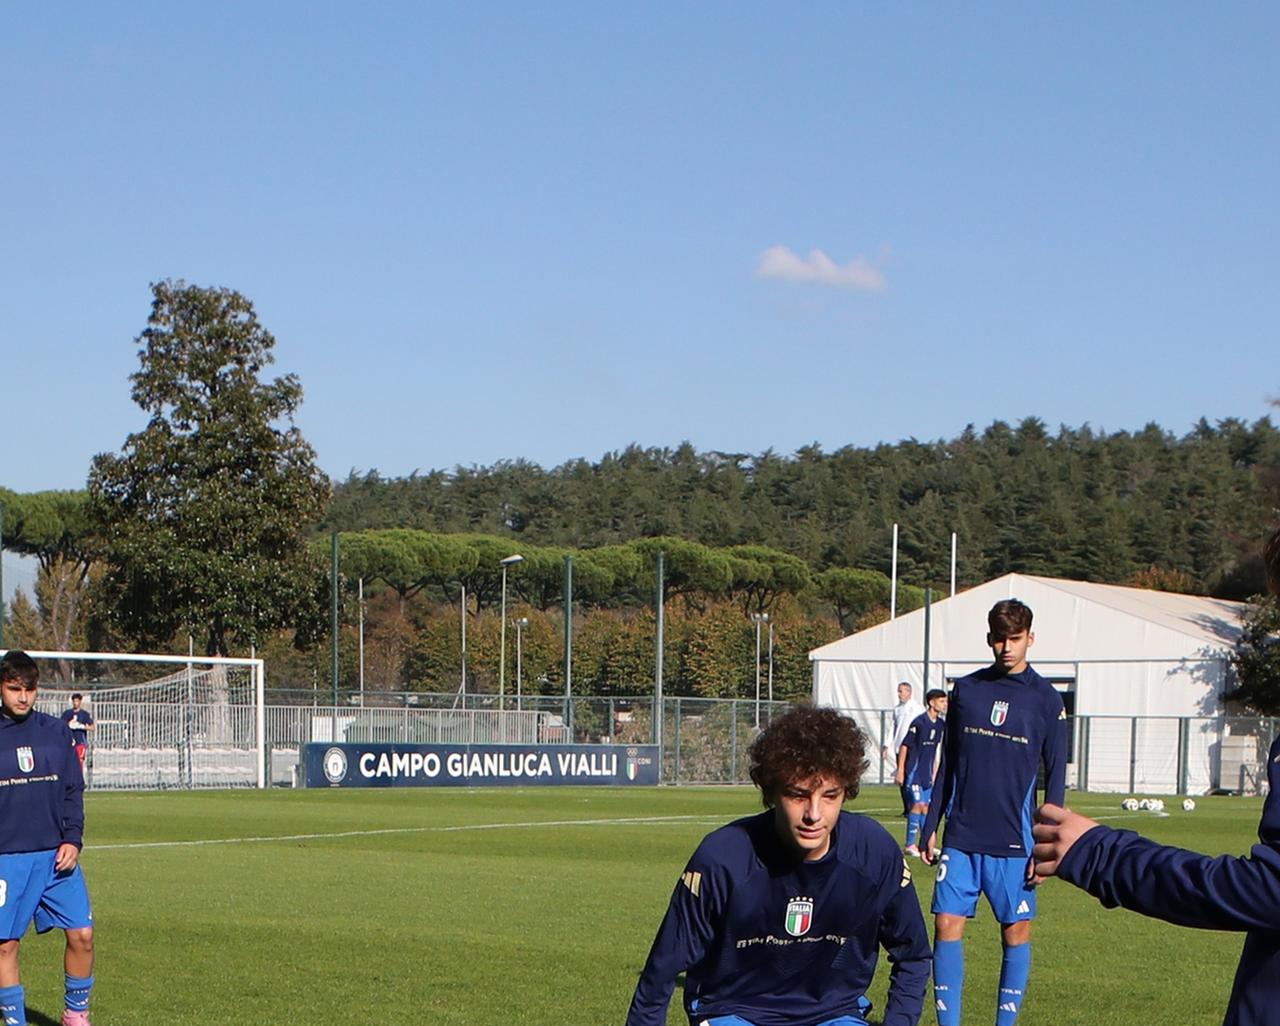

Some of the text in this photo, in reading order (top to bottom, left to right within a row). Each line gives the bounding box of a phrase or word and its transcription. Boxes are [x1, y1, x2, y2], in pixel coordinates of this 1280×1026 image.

[360, 752, 440, 778] CAMPO
[447, 752, 553, 777] GIANLUCA
[557, 753, 617, 776] VIALLI
